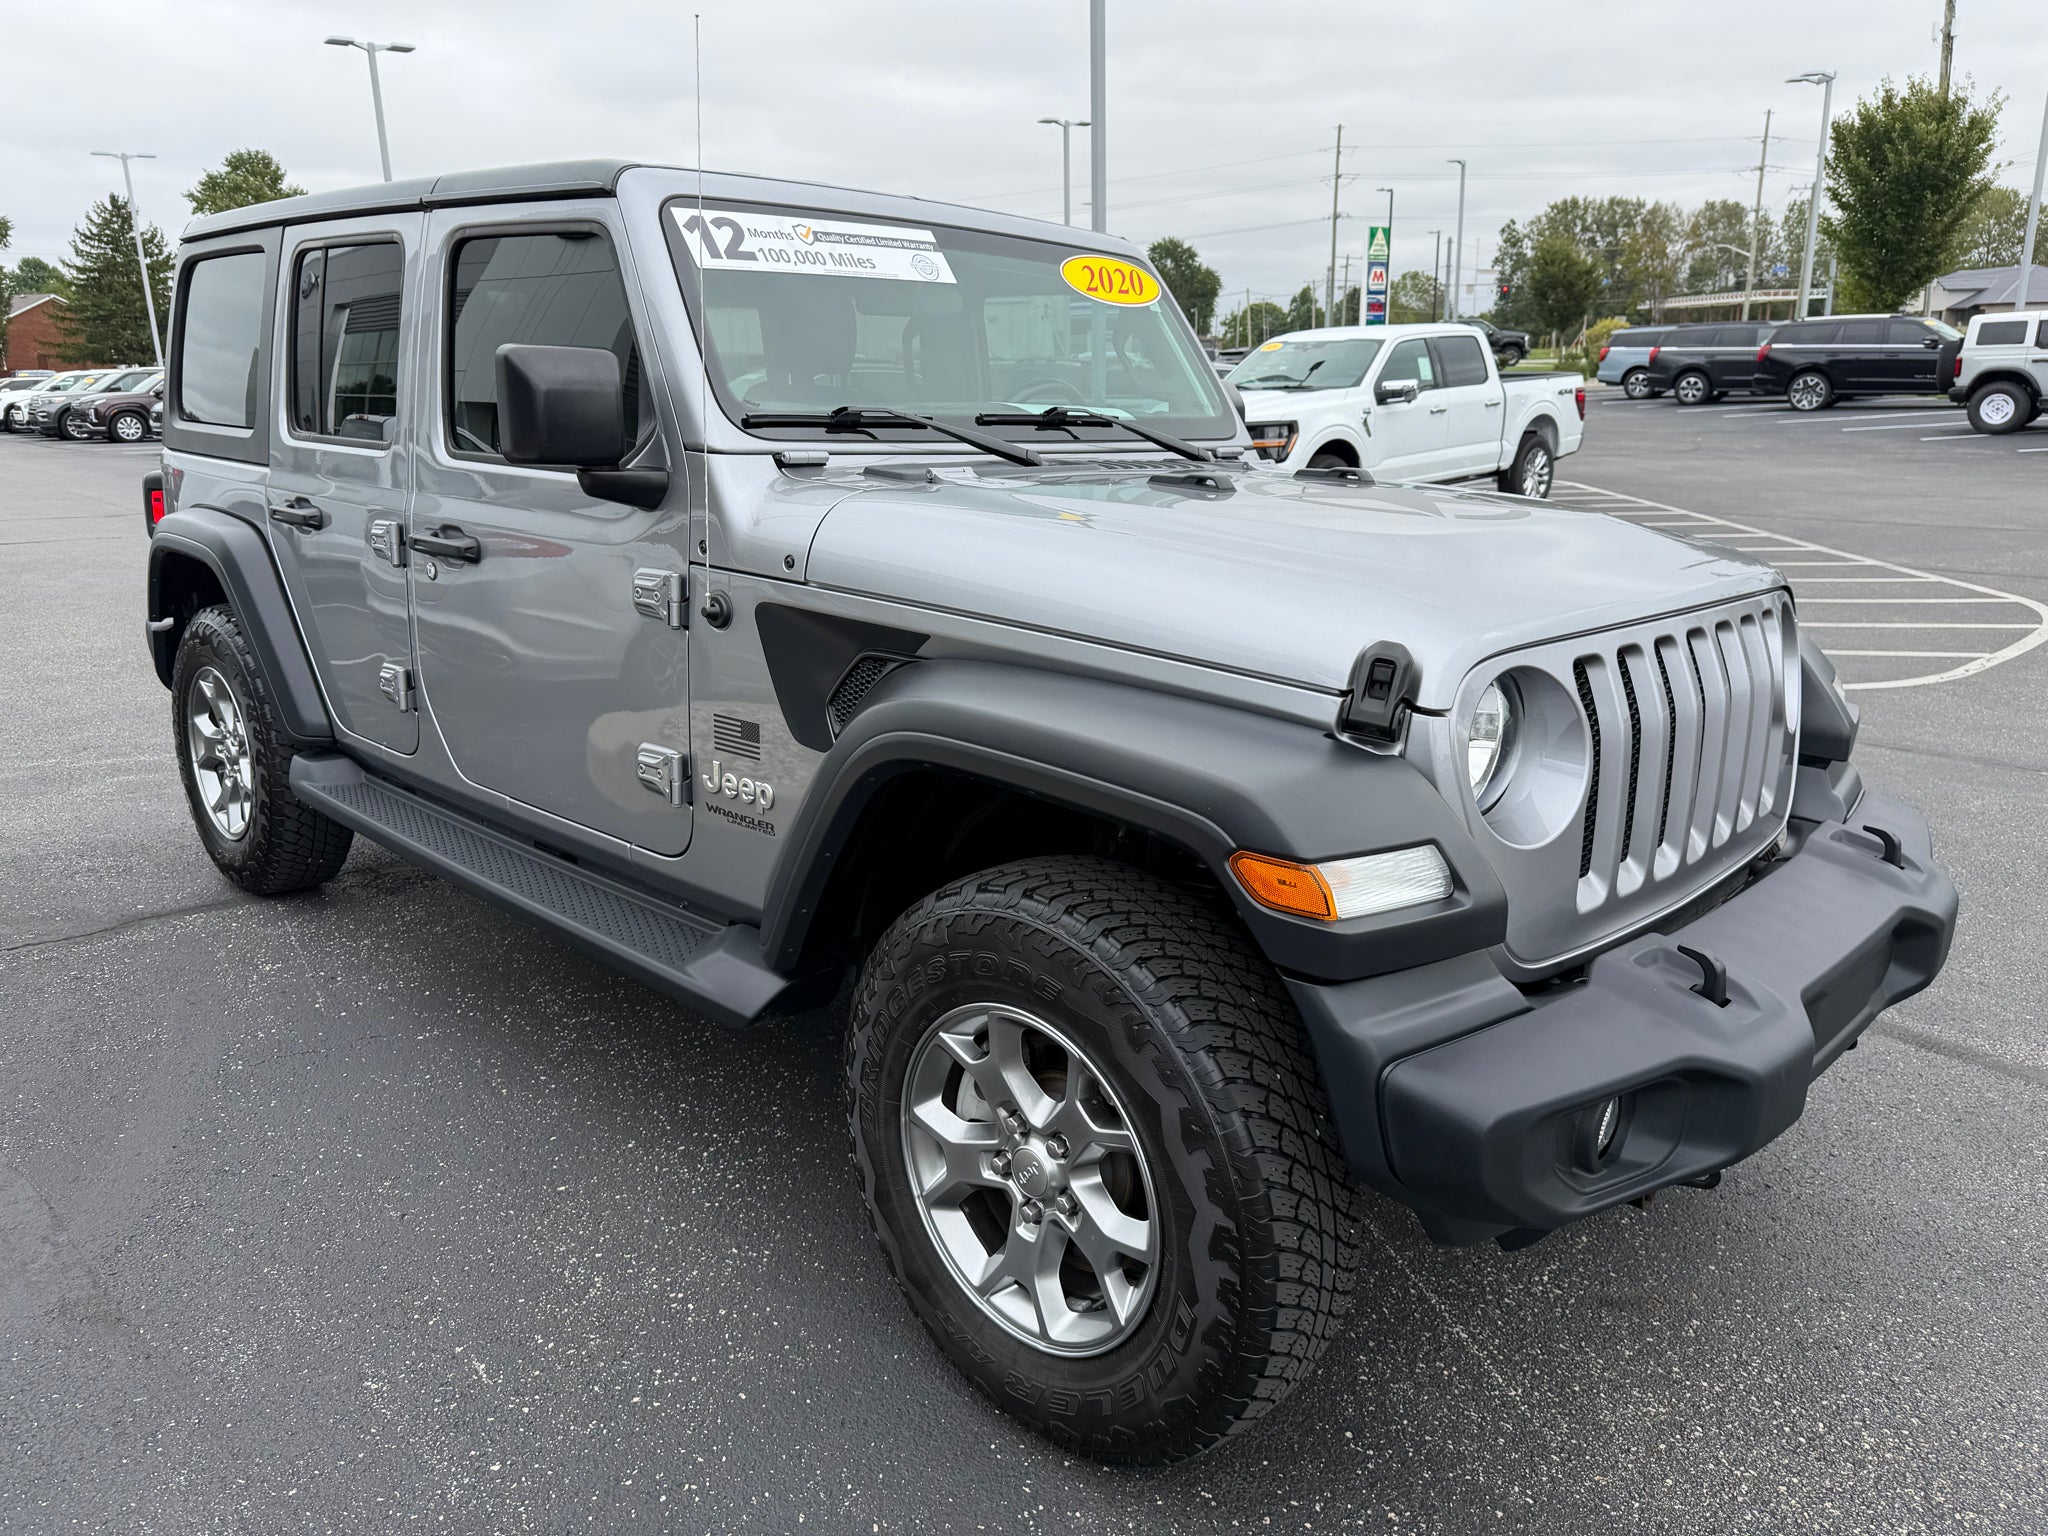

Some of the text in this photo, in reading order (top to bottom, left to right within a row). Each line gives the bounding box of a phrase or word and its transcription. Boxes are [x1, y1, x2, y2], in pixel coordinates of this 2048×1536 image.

[682, 215, 759, 261] 12
[746, 227, 795, 241] Months
[816, 233, 934, 252] Quality Certified Limited Warranty
[757, 248, 877, 270] 100,000 Miles
[1081, 265, 1144, 296] 2020
[1372, 270, 1385, 282] M
[702, 760, 775, 816] Jeep
[705, 802, 775, 833] WRANGLER
[726, 818, 776, 837] UNLIMITED
[858, 950, 1065, 1140] BRIDGESTONE
[1003, 1290, 1198, 1417] DUELER
